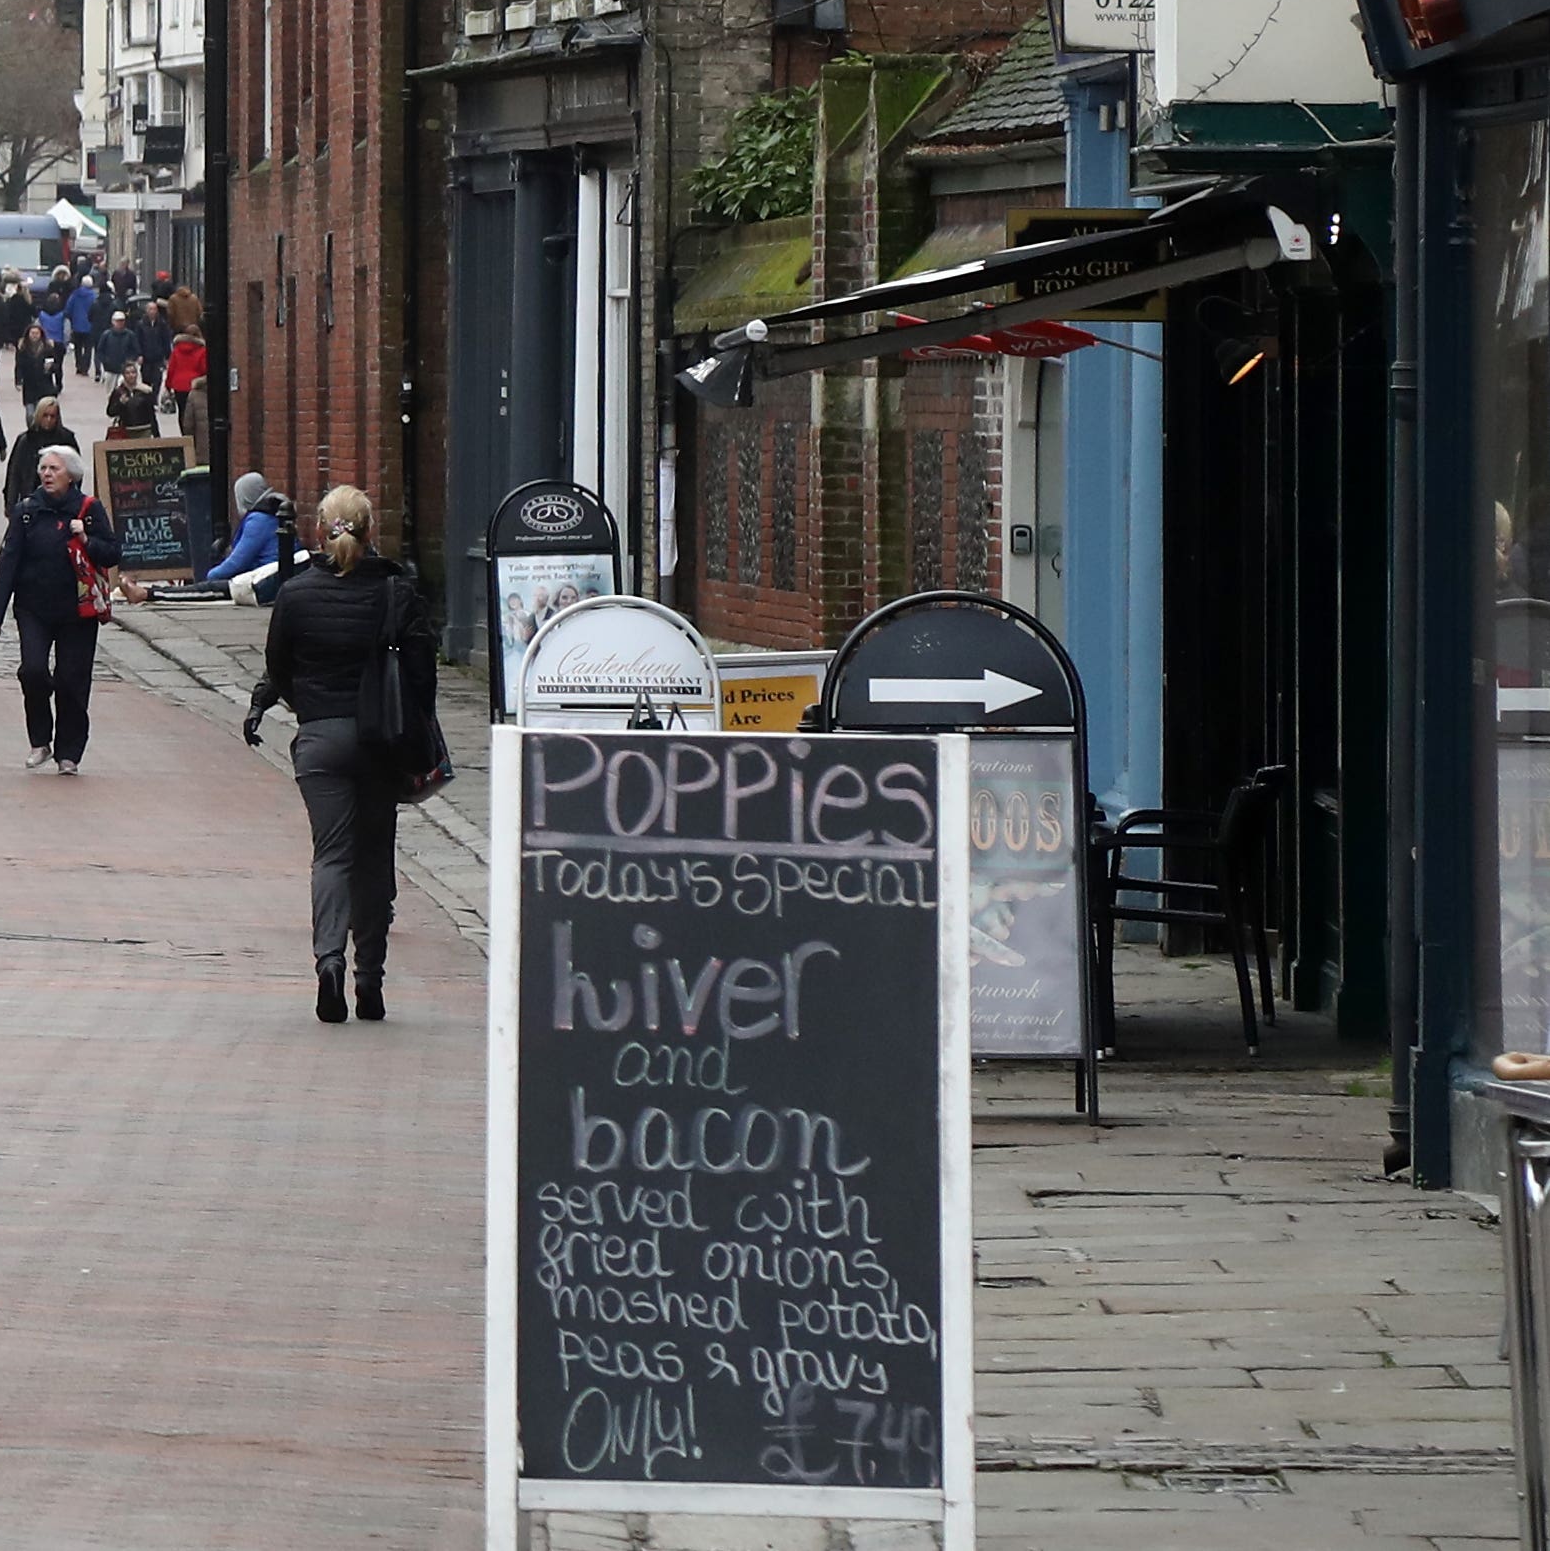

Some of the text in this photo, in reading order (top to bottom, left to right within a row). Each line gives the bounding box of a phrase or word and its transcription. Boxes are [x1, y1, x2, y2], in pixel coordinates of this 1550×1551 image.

[125, 530, 173, 543] MUSIC
[128, 517, 170, 531] LIVE
[556, 642, 681, 680] Canterbury
[619, 676, 702, 685] RESTAURANT
[730, 712, 762, 725] Are
[741, 689, 795, 703] Prices
[523, 849, 937, 918] Today's Special
[613, 1029, 748, 1095] and
[570, 1086, 871, 1175] bacon
[537, 1172, 882, 1244] served with
[537, 1224, 674, 1291] fried
[551, 1279, 749, 1333] mashed
[558, 1328, 685, 1390] peas
[751, 1346, 889, 1416] gravy
